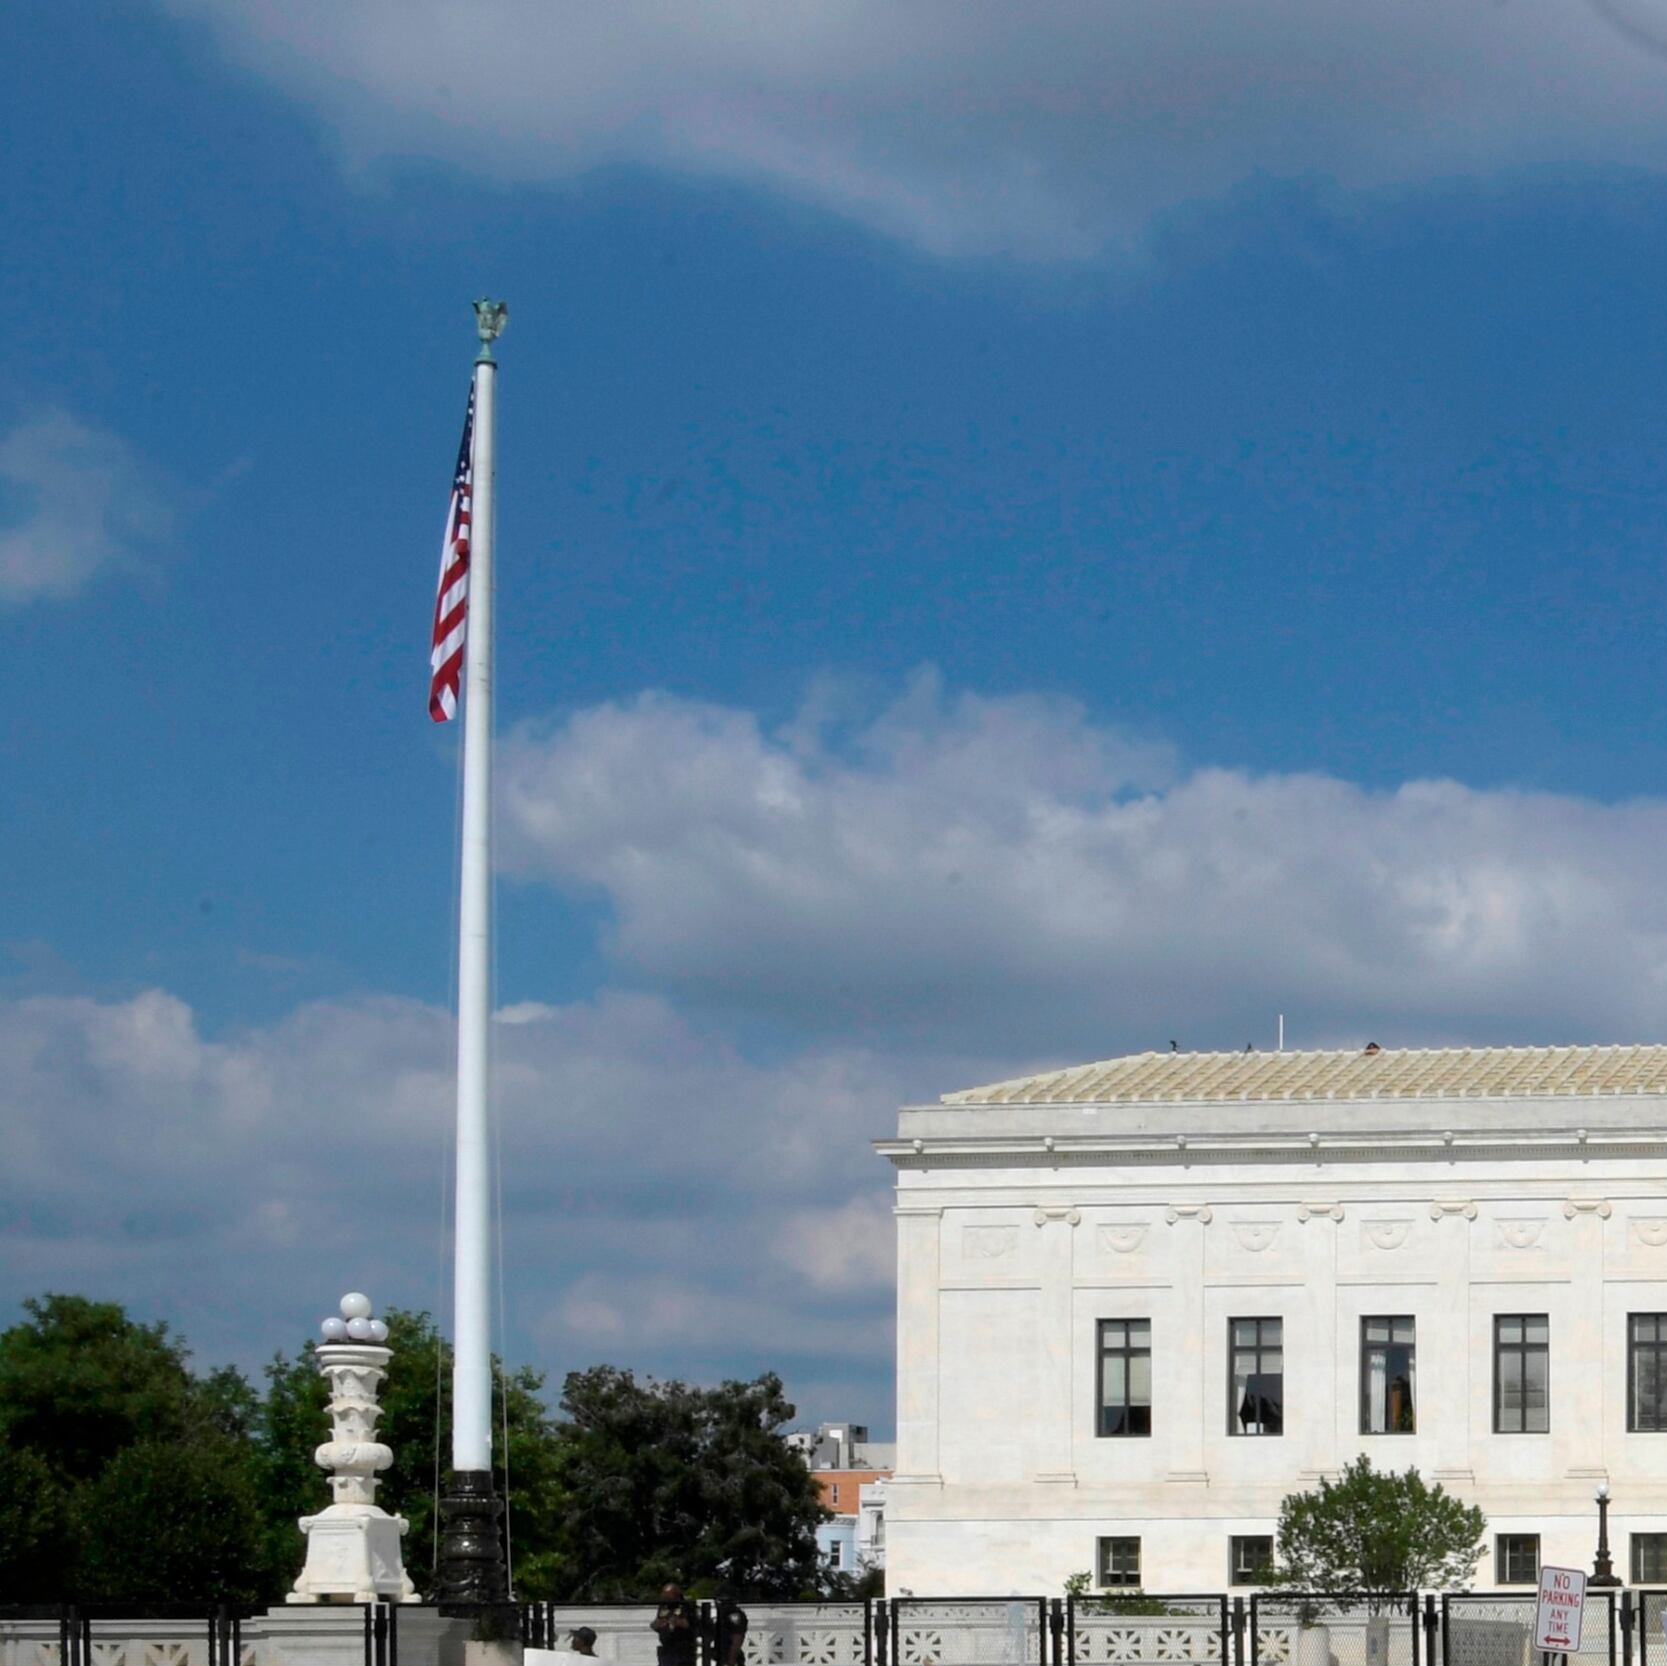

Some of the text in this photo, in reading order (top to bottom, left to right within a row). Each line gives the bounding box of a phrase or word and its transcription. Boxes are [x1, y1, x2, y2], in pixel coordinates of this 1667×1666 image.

[1552, 1574, 1572, 1590] NO
[1541, 1590, 1580, 1608] PARKING
[1549, 1610, 1569, 1621] ANY
[1549, 1621, 1569, 1635] TIME
